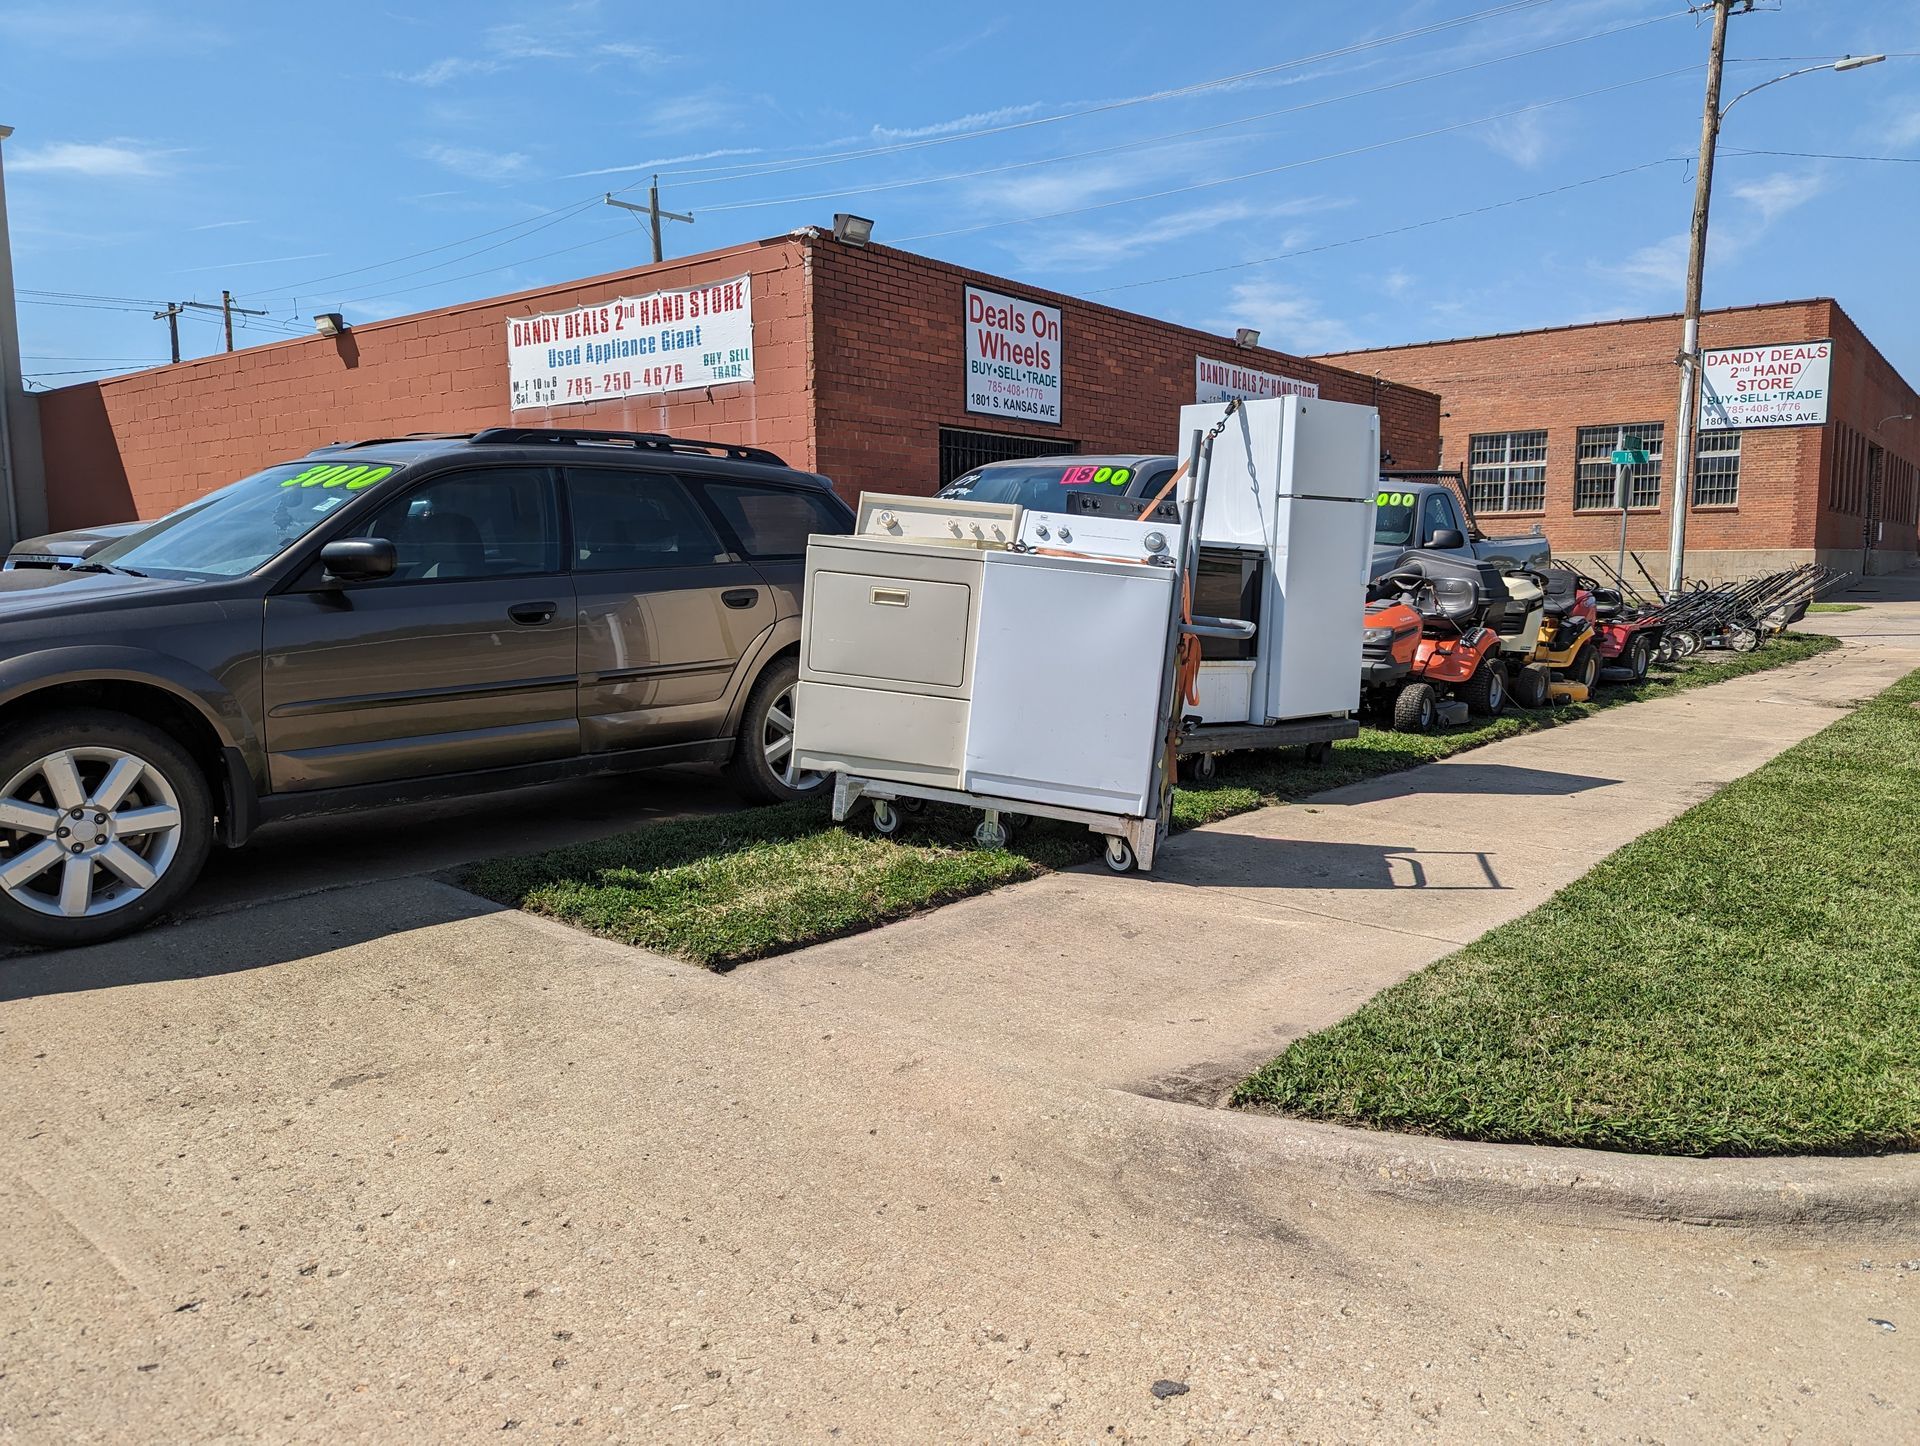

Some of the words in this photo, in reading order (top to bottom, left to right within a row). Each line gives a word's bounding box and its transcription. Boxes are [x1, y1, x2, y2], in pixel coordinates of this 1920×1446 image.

[513, 315, 560, 347] DANDY
[564, 308, 609, 339] DEALS
[614, 303, 635, 331] 2nd
[640, 292, 684, 326] HAND
[690, 282, 744, 318] STORE
[969, 294, 1026, 334] Deals
[1032, 310, 1058, 341] On
[547, 344, 581, 368] Used
[586, 333, 656, 365] Appliance
[661, 325, 702, 352] Giant
[730, 347, 750, 363] SELL
[978, 329, 1051, 370] Wheels
[1707, 351, 1765, 367] DANDY
[1771, 346, 1828, 362] DEALS
[566, 363, 684, 398] 785-250-4676
[712, 364, 742, 380] TRADE
[1200, 362, 1230, 387] DANDY
[1232, 370, 1257, 393] DEALS
[1730, 365, 1750, 379] 2nd
[1753, 362, 1802, 377] HAND
[533, 378, 542, 390] 10
[552, 376, 557, 388] 6
[1736, 377, 1794, 392] STORE
[535, 391, 540, 402] 9
[550, 389, 555, 401] 6
[971, 393, 990, 407] 1801
[993, 396, 1001, 409] S.
[1003, 399, 1038, 414] KANSAS
[1040, 404, 1057, 417] AVE.
[1705, 417, 1728, 426] 1801
[1745, 414, 1792, 423] KANSAS
[1796, 412, 1821, 421] AVE.
[1060, 465, 1130, 486] 1800
